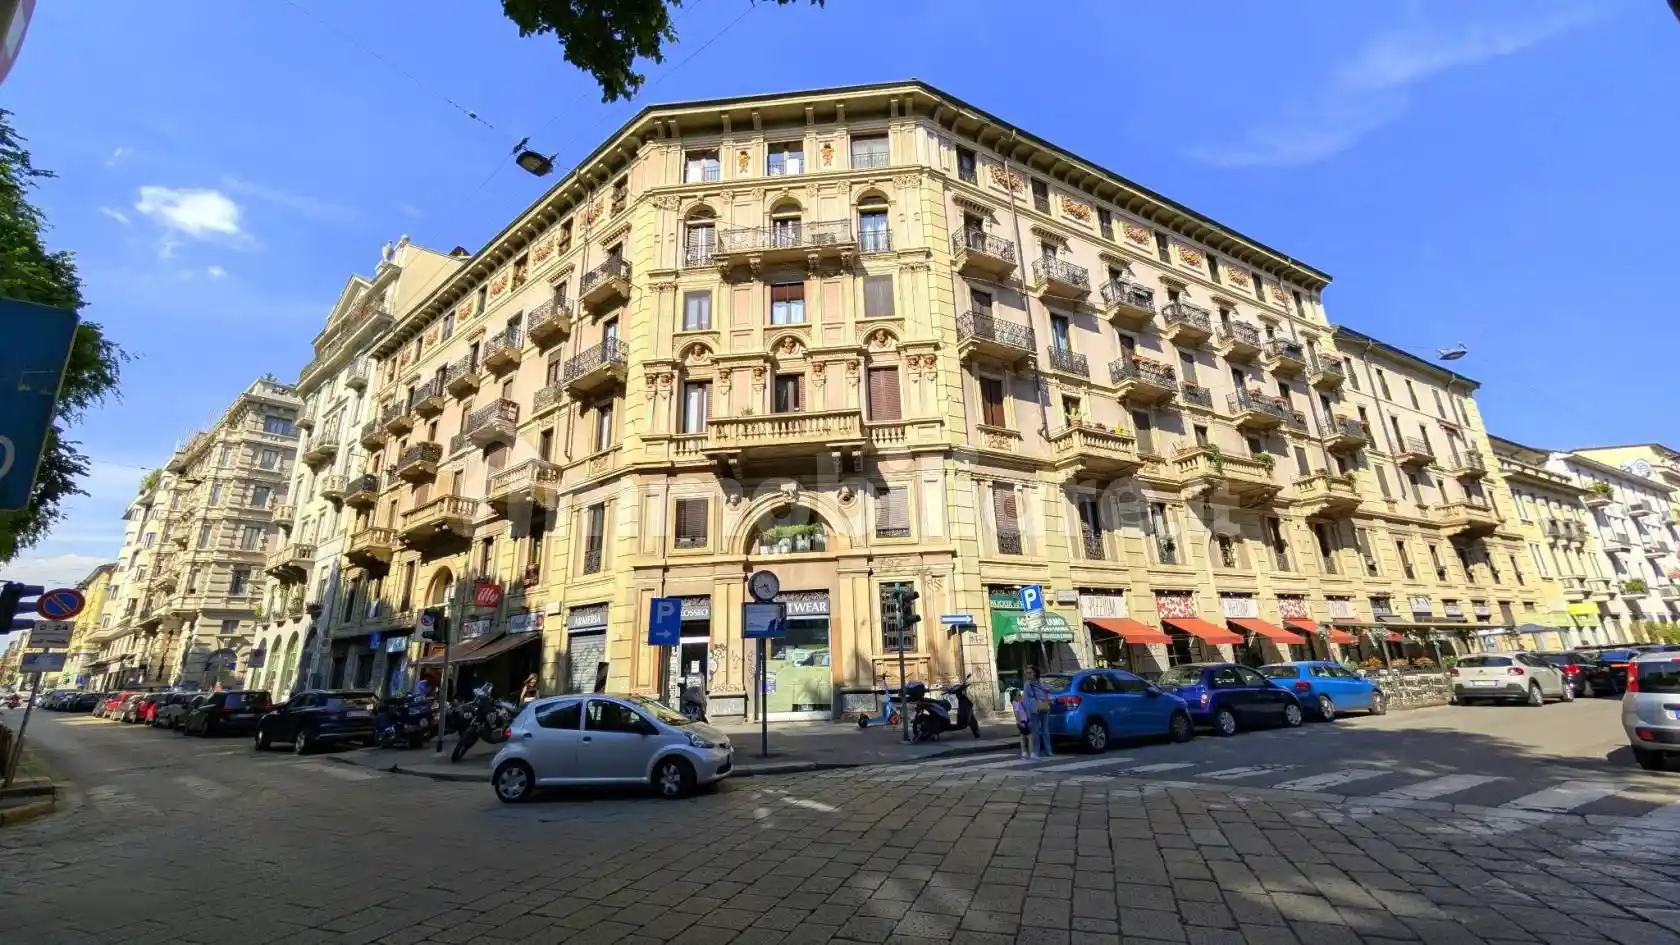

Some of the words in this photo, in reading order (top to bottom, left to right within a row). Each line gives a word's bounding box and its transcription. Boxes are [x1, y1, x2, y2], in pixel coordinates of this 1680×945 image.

[477, 588, 499, 604] illy
[1024, 589, 1038, 609] P
[656, 602, 675, 624] P
